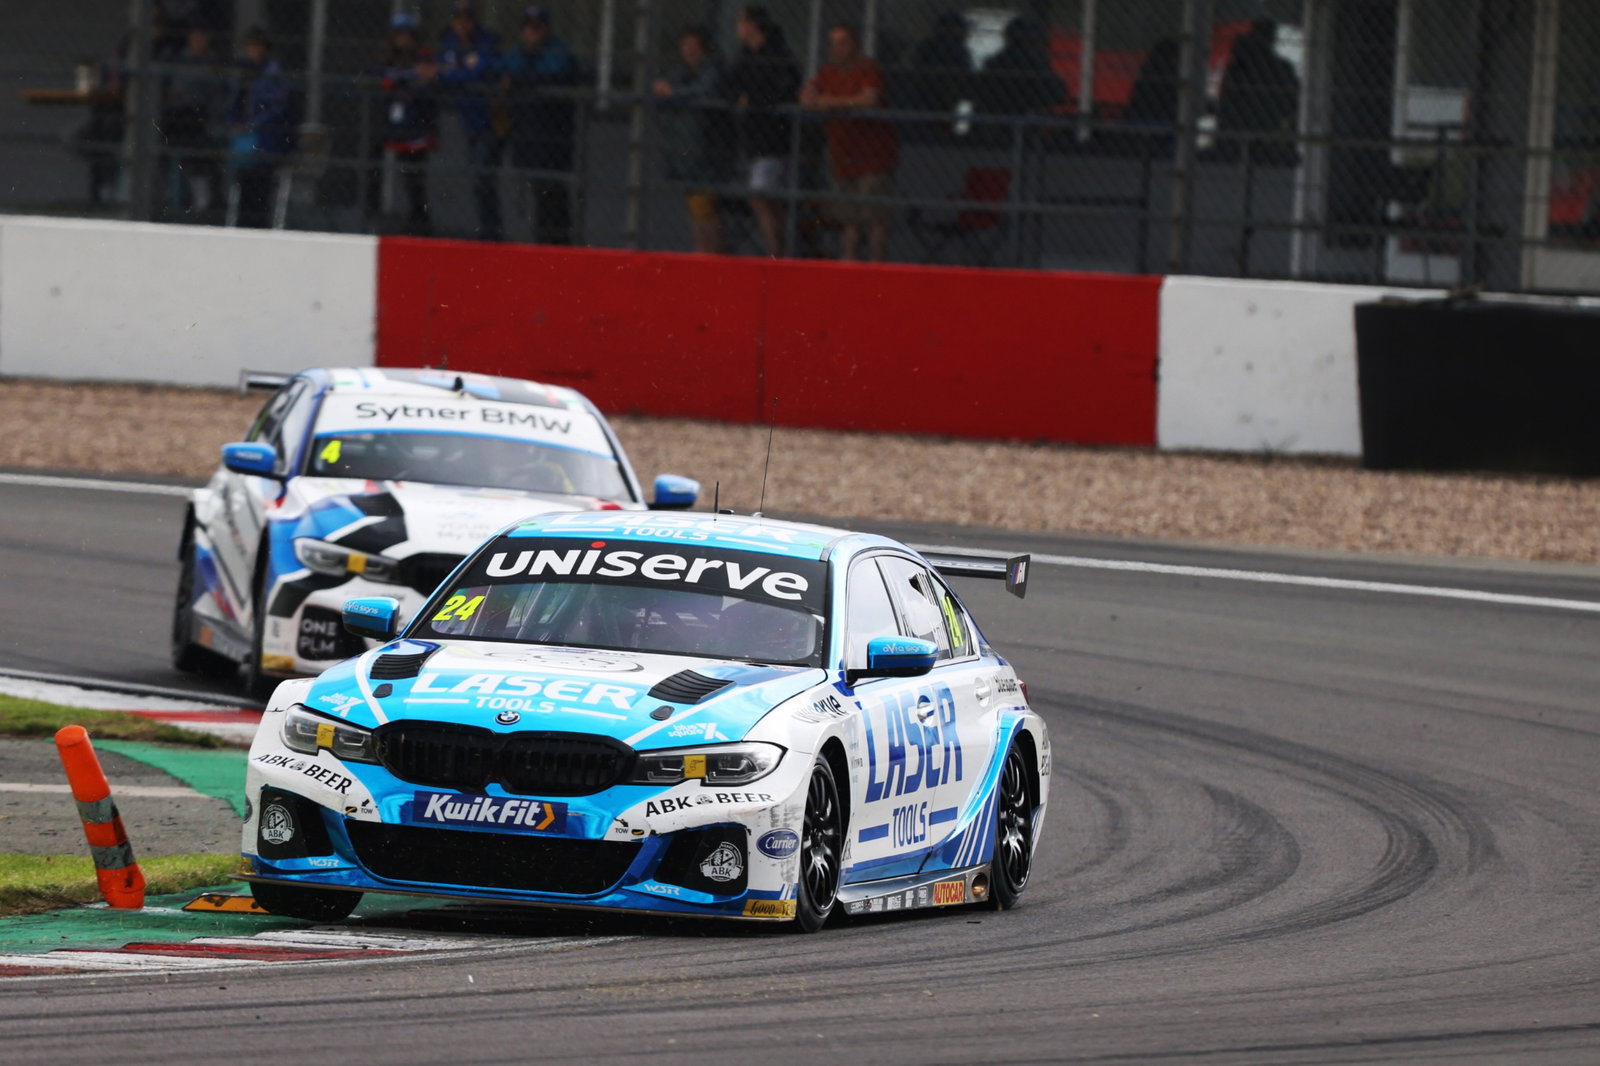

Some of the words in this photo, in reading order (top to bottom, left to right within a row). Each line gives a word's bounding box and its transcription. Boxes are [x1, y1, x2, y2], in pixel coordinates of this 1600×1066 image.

[355, 402, 470, 421] Sytner
[481, 408, 572, 434] BMW
[320, 440, 342, 464] 4
[551, 514, 798, 543] LASER
[622, 526, 709, 541] TOOLS
[431, 595, 486, 622] 24
[302, 618, 337, 636] ONE
[410, 673, 638, 711] LASER
[475, 696, 556, 713] TOOLS
[862, 681, 963, 804] LASER
[253, 754, 295, 768] ABK
[303, 764, 352, 795] BEER
[645, 796, 694, 818] ABK
[715, 793, 775, 804] BEER
[268, 829, 285, 839] ABK
[892, 801, 928, 848] TOOLS
[764, 836, 797, 850] Carrier
[711, 865, 733, 877] ABK
[933, 881, 964, 905] AUTOCAR
